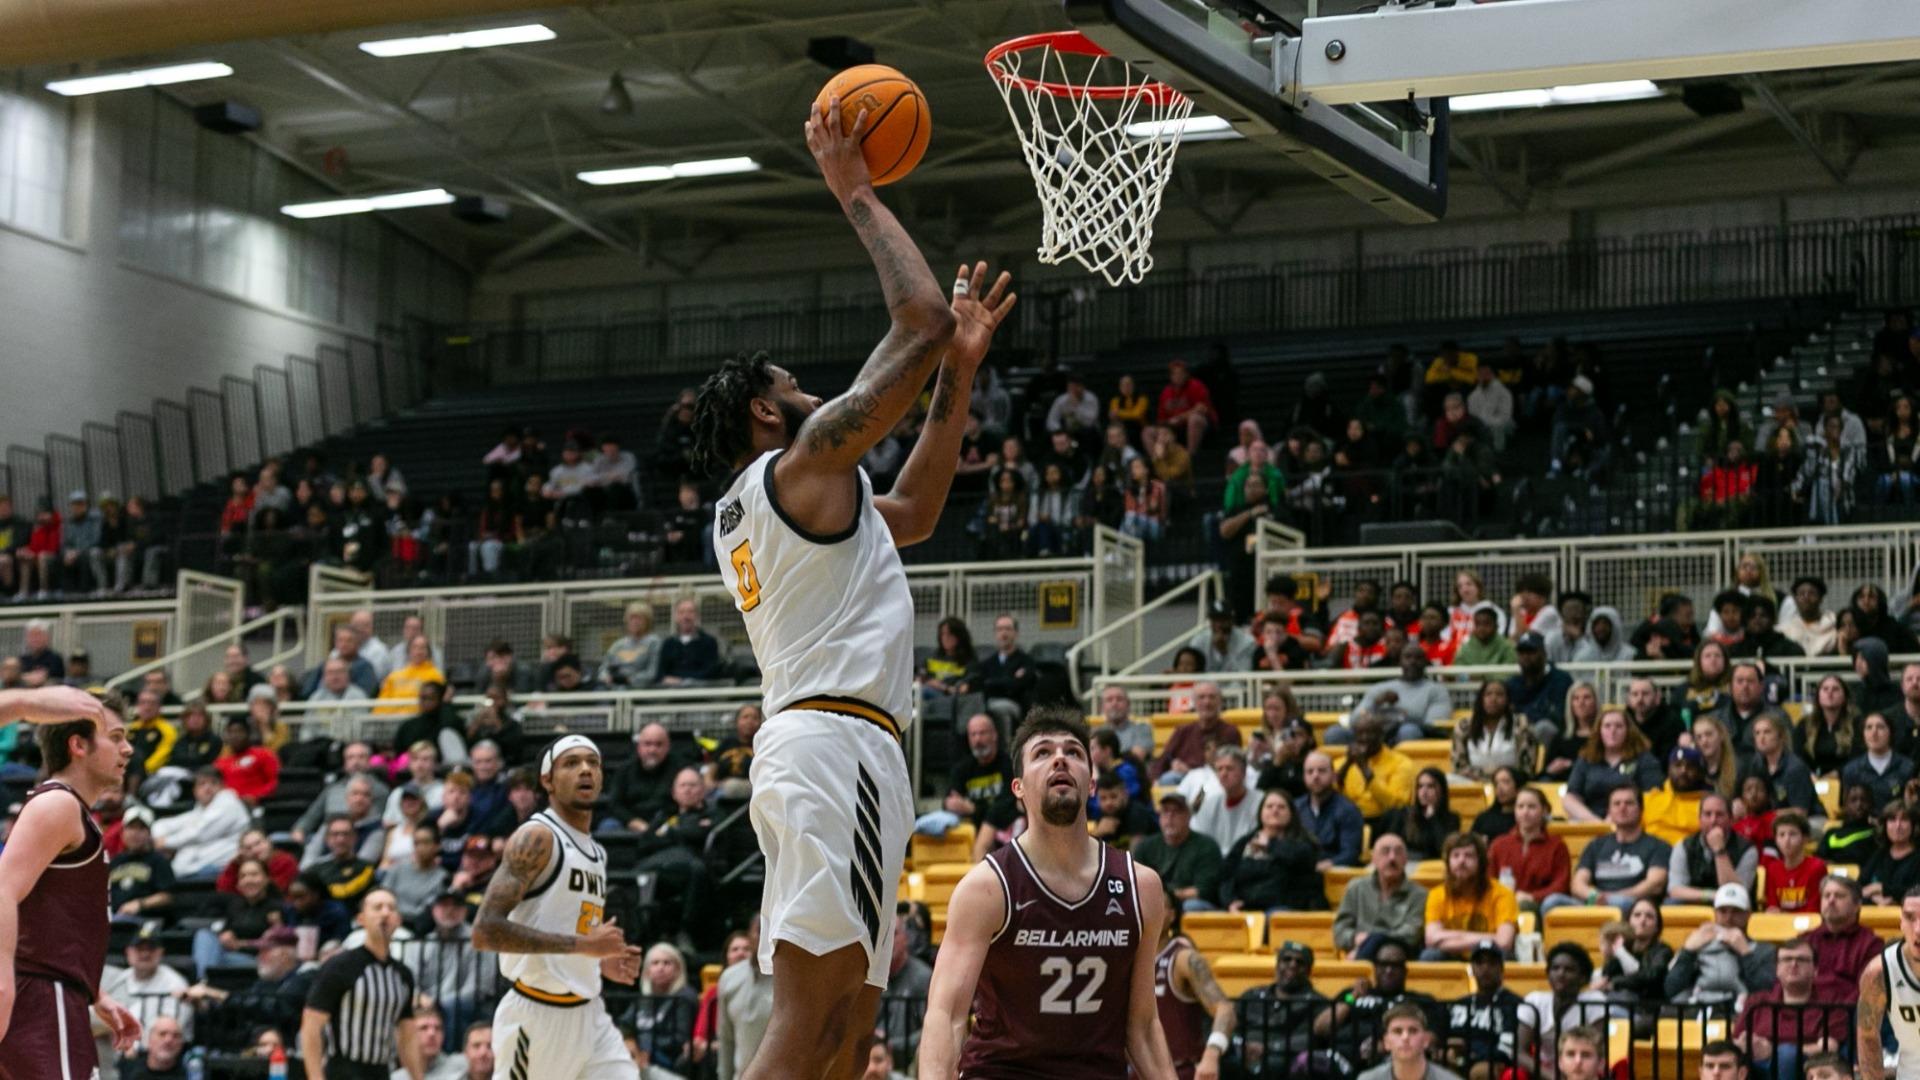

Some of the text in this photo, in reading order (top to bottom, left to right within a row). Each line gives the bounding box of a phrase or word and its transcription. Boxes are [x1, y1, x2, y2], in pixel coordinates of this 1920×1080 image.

[731, 538, 762, 612] 0
[1108, 879, 1124, 893] CG
[1014, 929, 1129, 947] BELLARMINE
[1040, 956, 1108, 1014] 22
